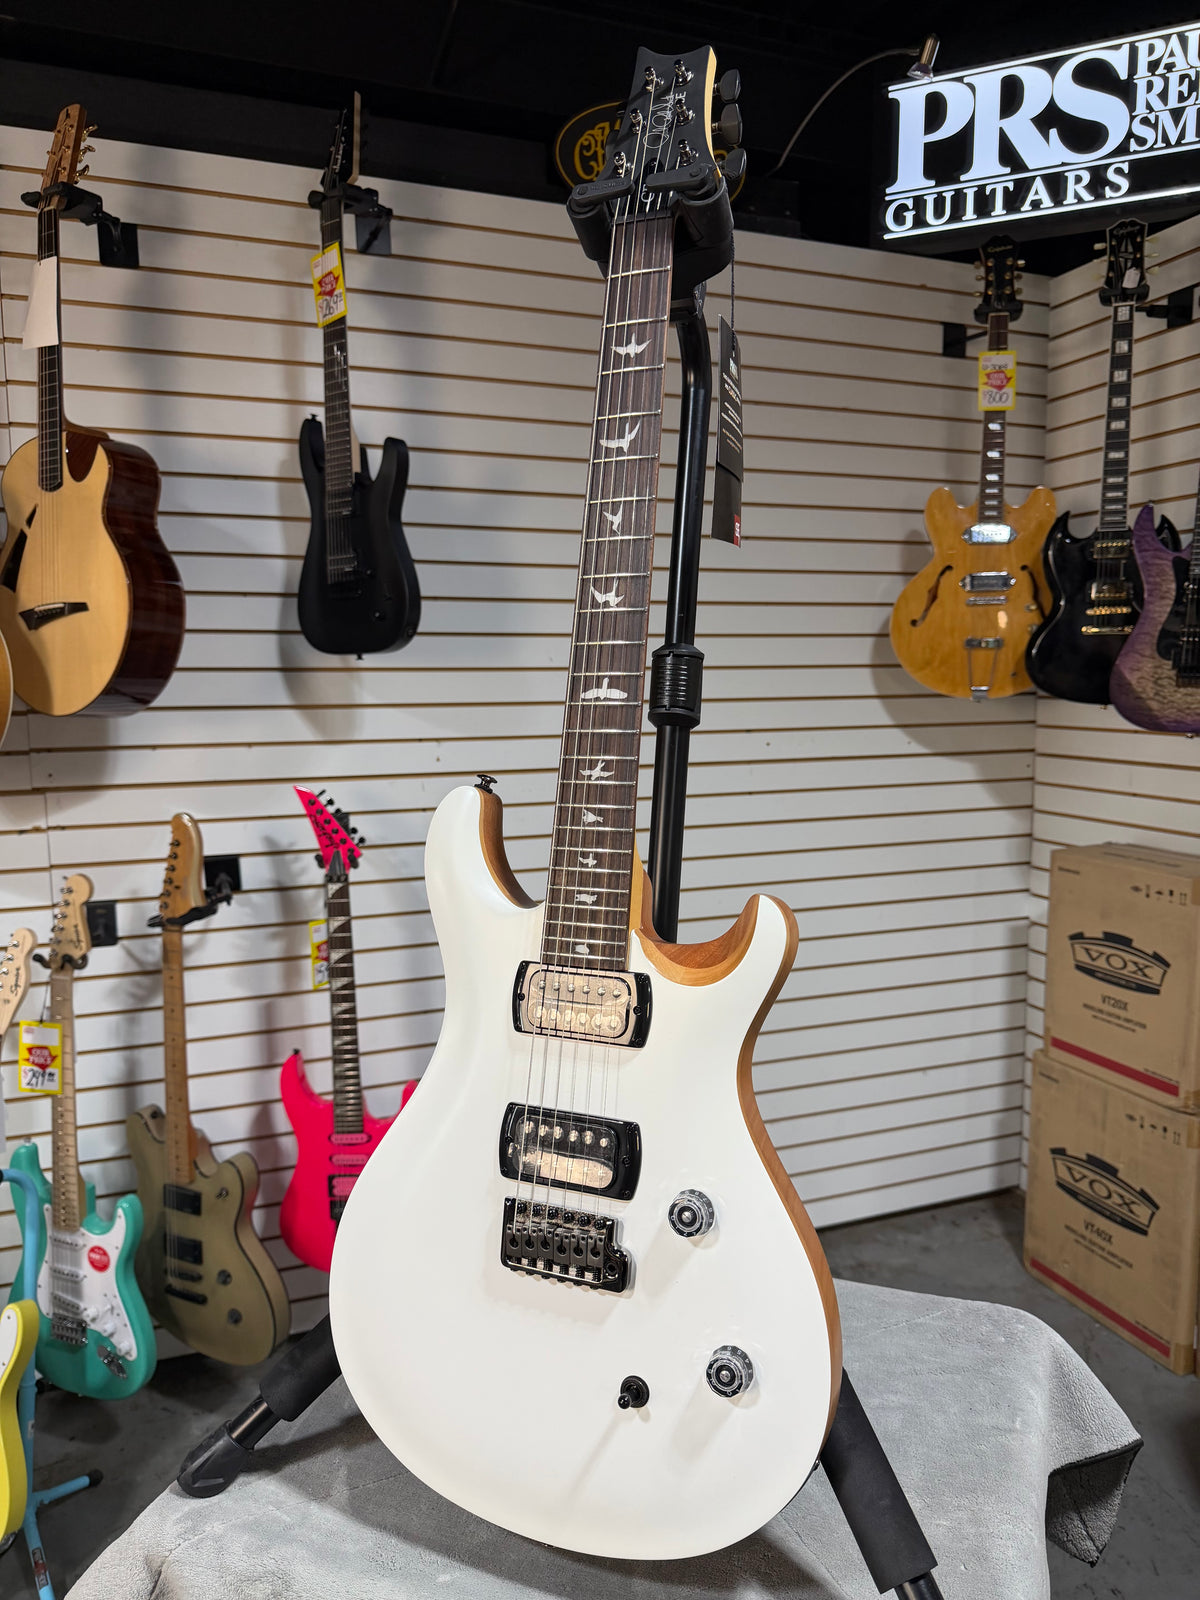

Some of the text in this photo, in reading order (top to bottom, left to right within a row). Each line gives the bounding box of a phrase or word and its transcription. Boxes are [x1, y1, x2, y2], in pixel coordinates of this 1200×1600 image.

[886, 43, 1130, 194] PRS
[1132, 67, 1200, 115] RE
[884, 162, 1129, 232] GUITARS
[1080, 946, 1154, 980] VOX
[1061, 1162, 1141, 1218] VOX
